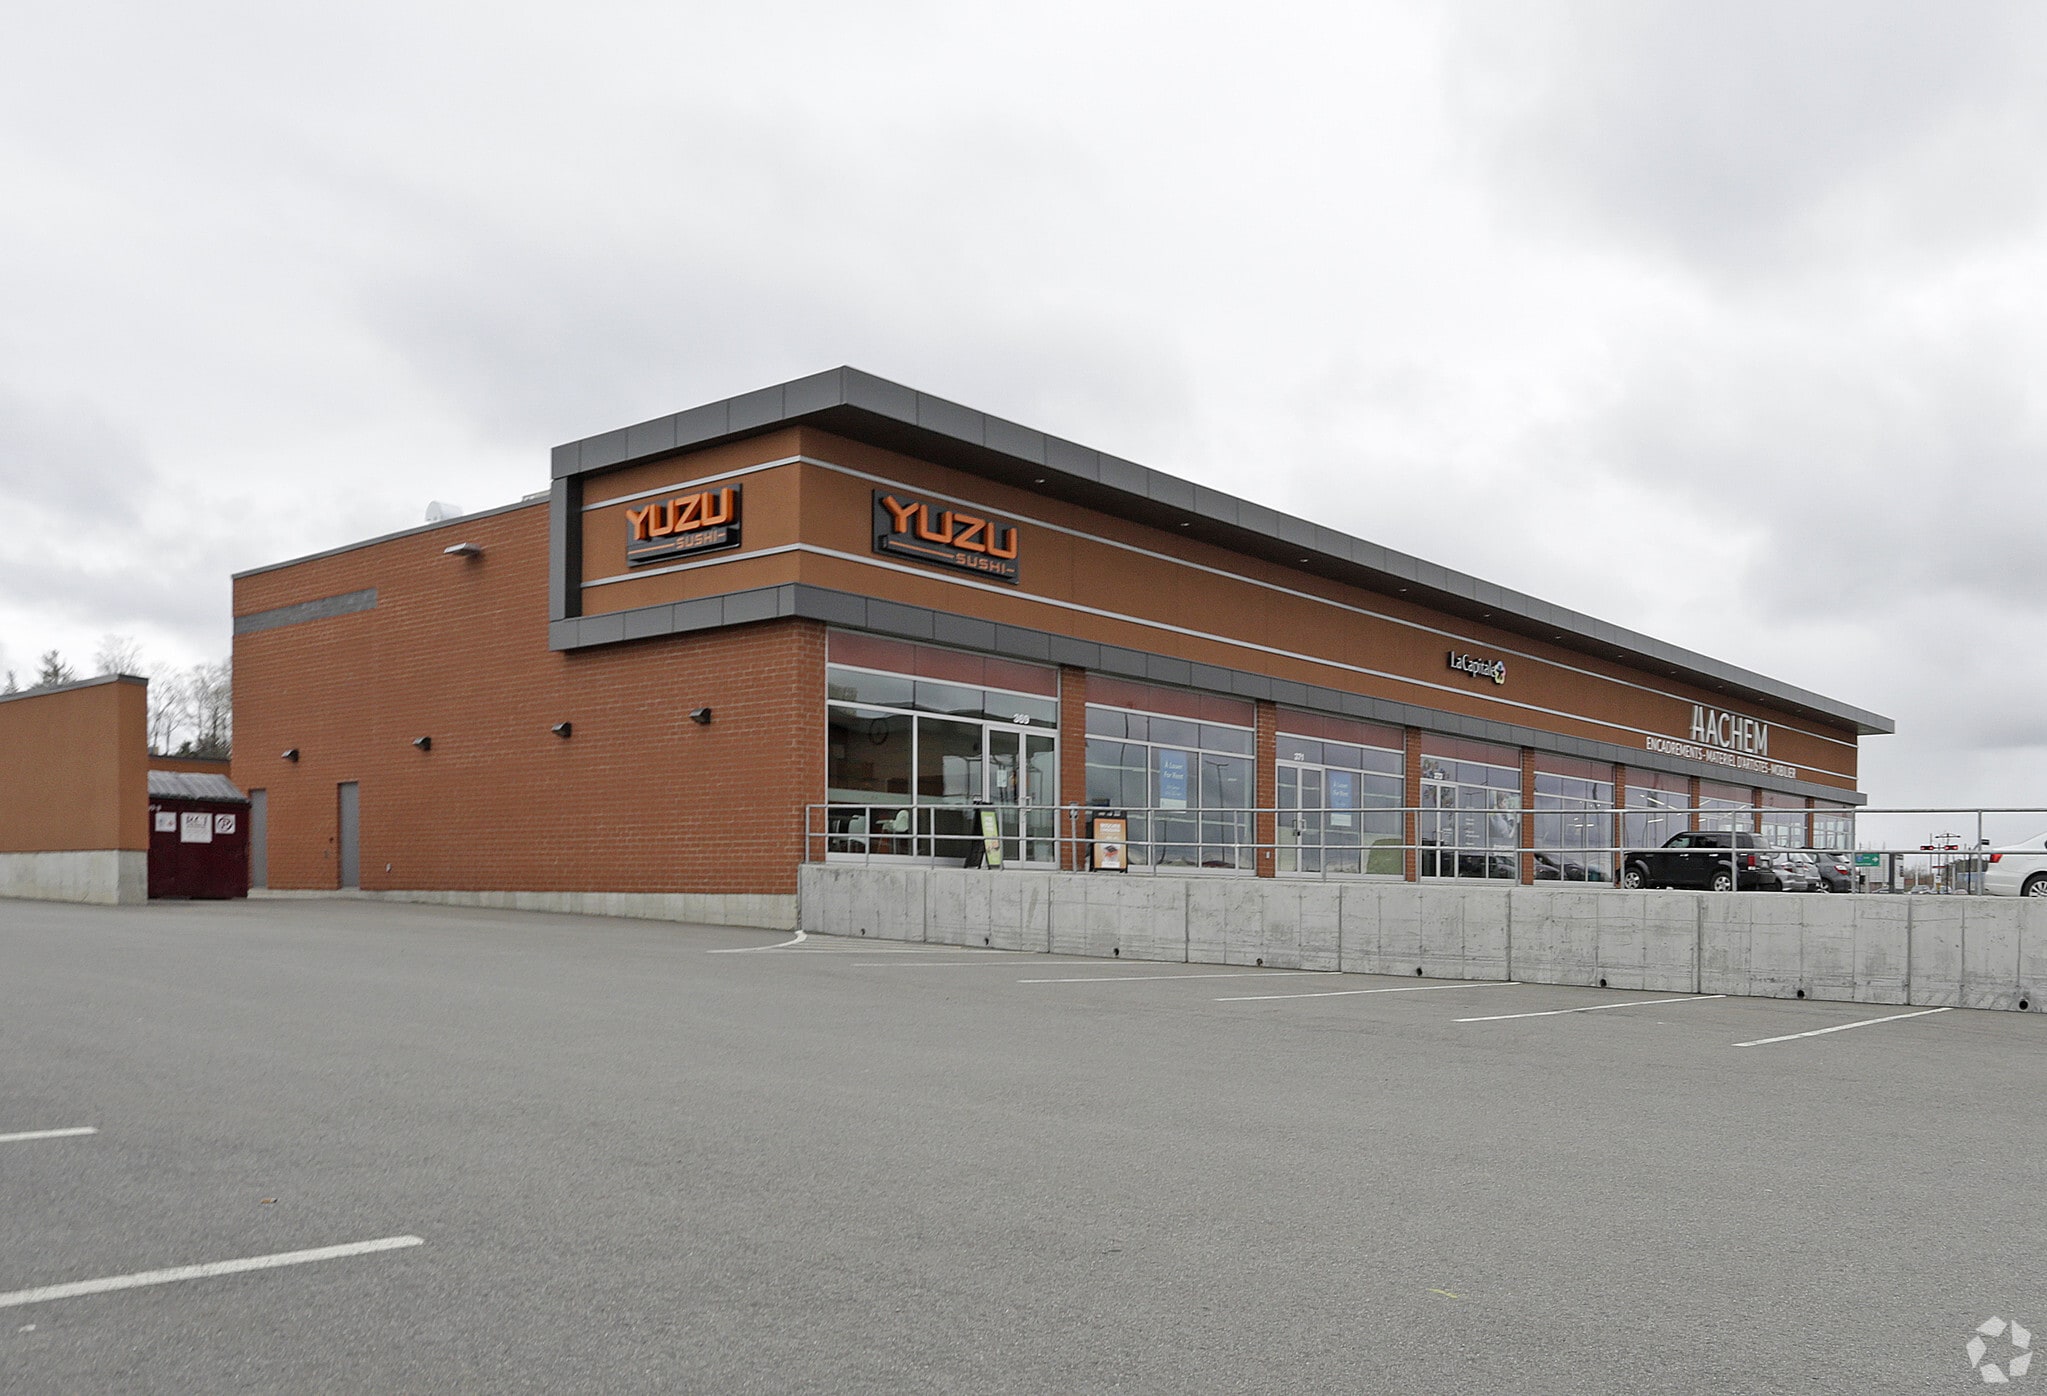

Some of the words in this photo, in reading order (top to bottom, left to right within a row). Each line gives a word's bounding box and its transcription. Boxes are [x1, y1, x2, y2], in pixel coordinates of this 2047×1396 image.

[626, 487, 734, 541] YUZU
[882, 495, 1018, 560] YUZU
[1690, 704, 1768, 757] HACHEM
